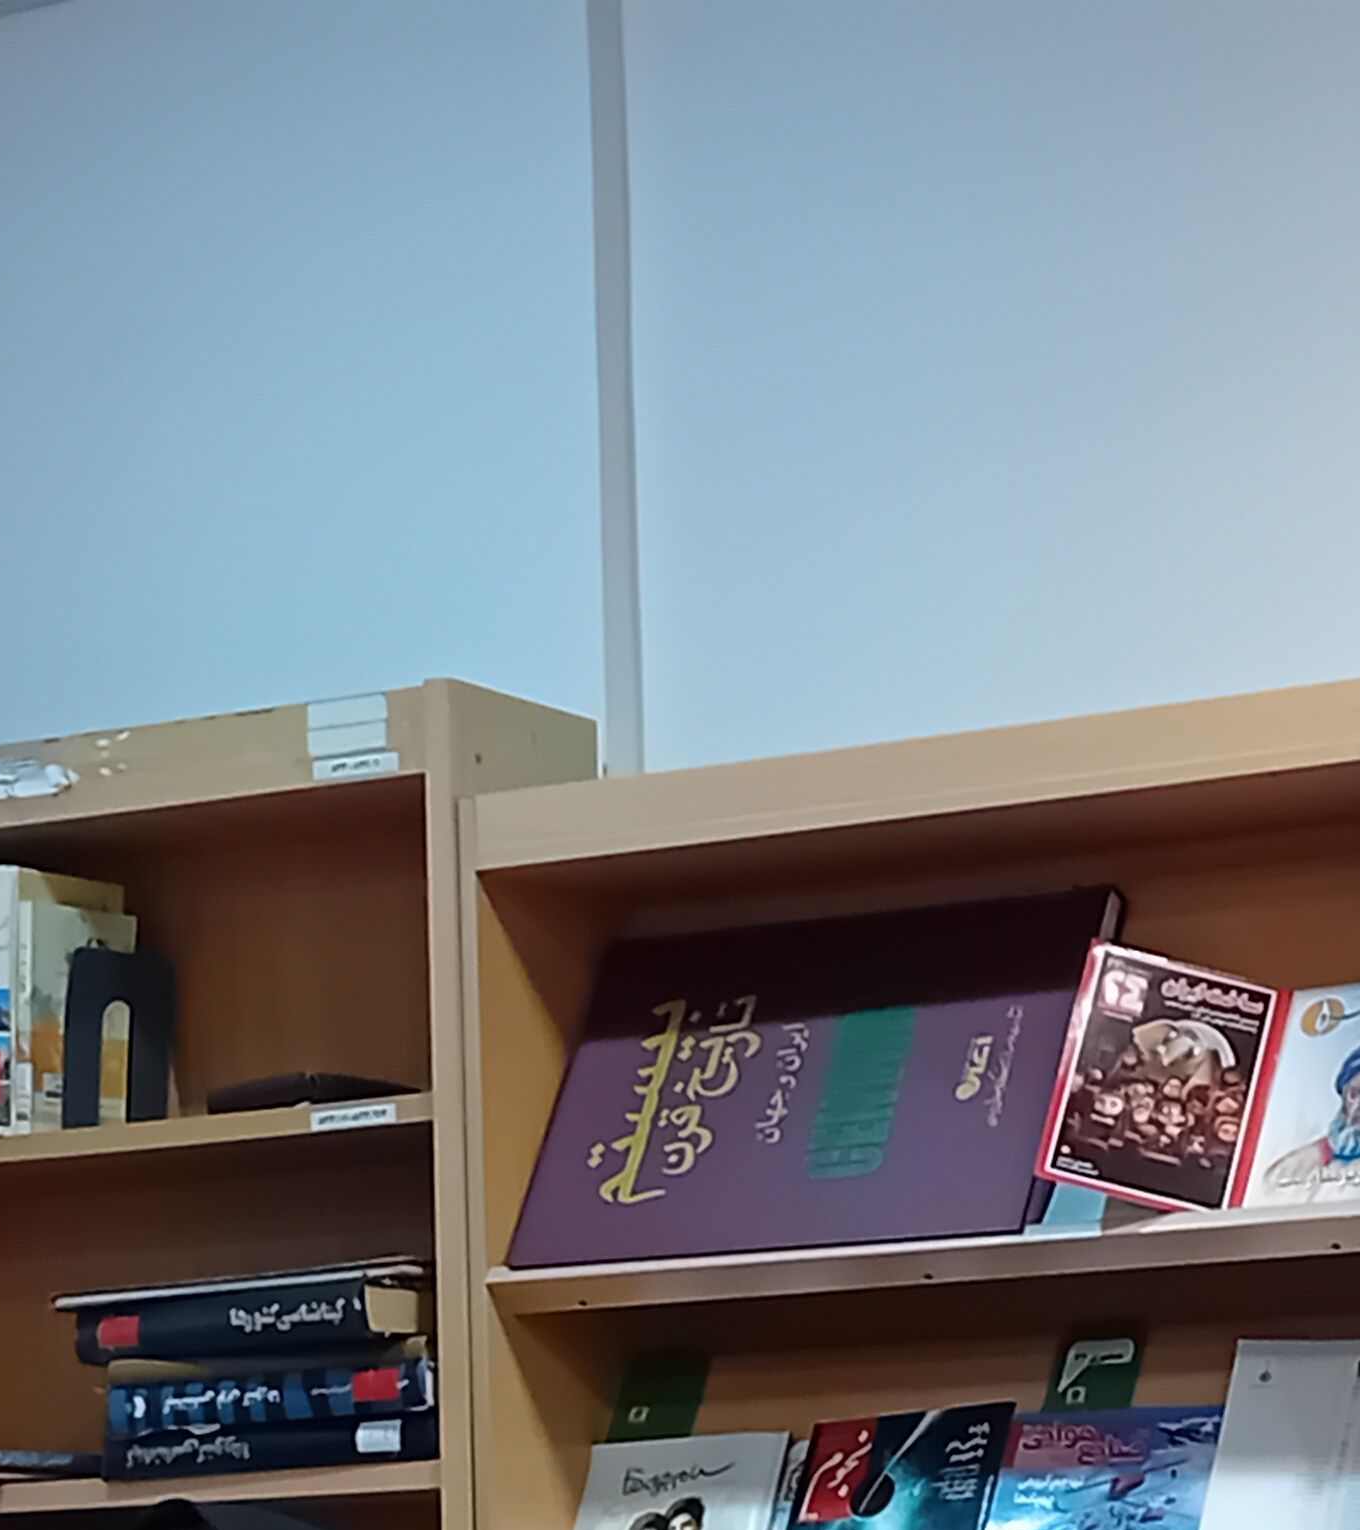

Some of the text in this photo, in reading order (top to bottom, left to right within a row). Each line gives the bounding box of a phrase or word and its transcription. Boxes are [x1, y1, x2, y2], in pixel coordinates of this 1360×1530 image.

[658, 994, 762, 1176] تاریخ قرن
[776, 1022, 810, 1072] ایران
[585, 998, 703, 1206] بیستم
[752, 1090, 790, 1145] جهان
[797, 1429, 873, 1521] نجوم
